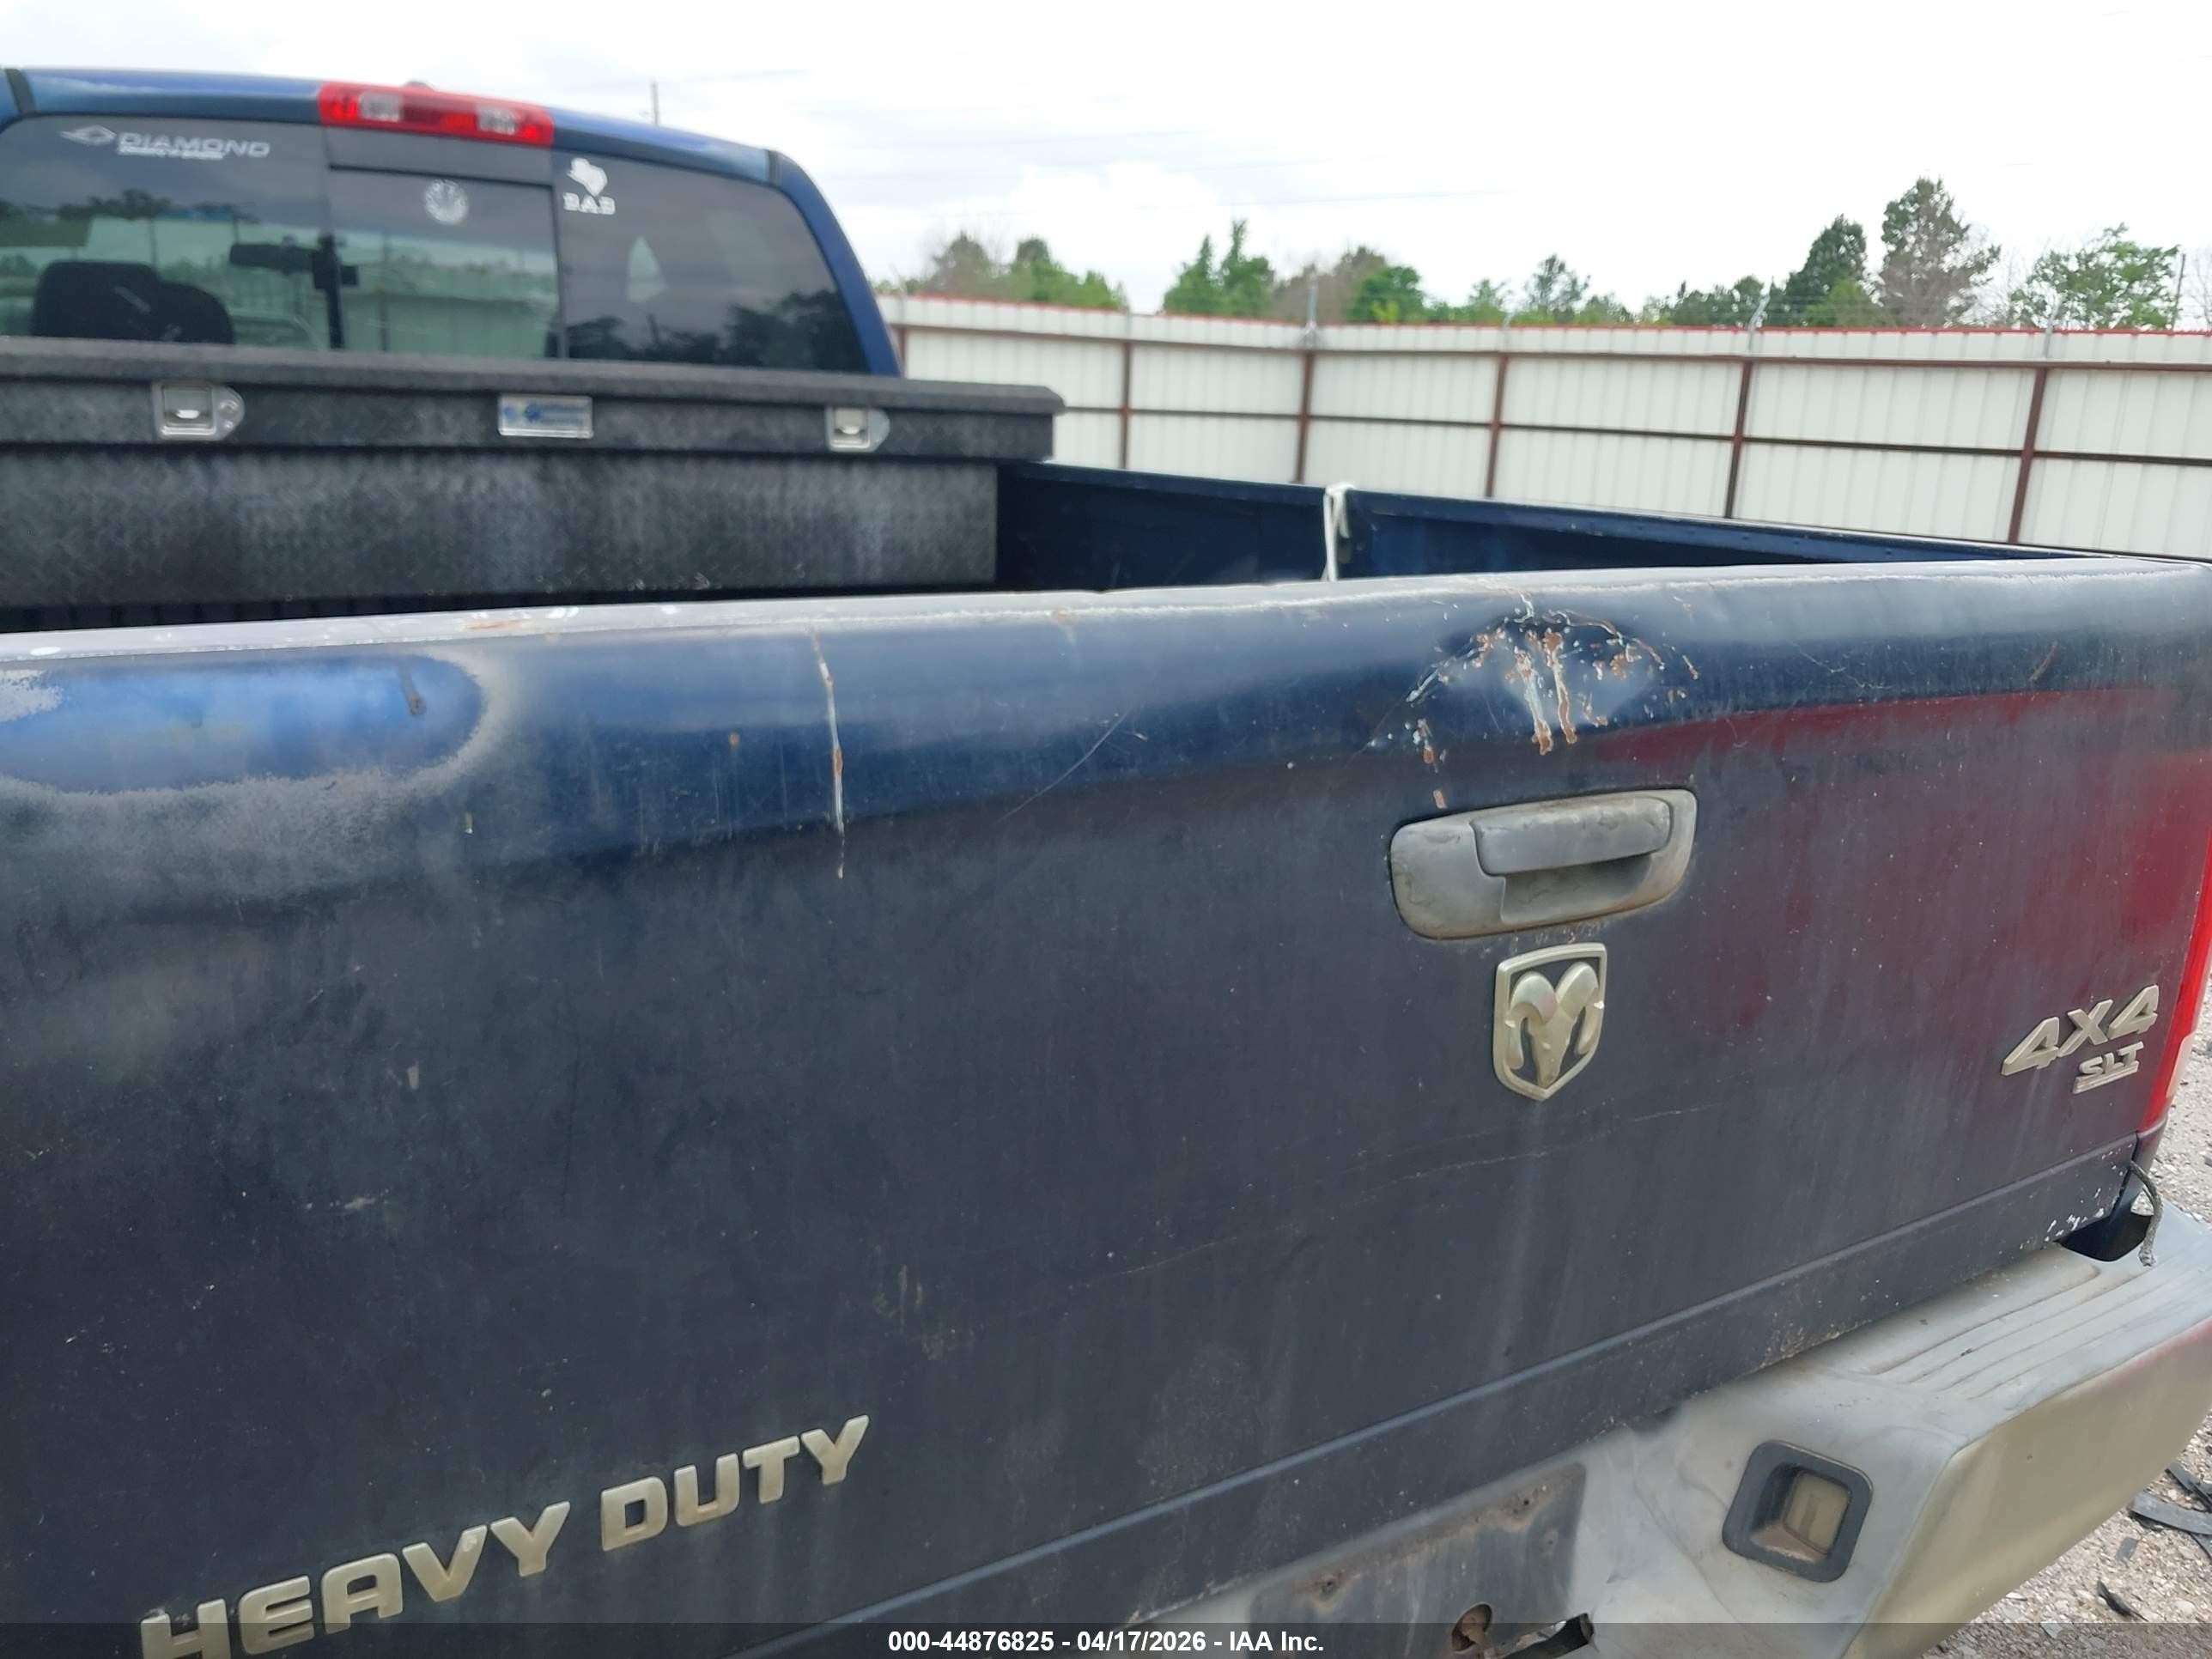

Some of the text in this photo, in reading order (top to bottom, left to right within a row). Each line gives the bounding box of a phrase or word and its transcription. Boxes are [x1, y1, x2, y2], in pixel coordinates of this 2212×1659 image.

[118, 132, 270, 159] DIAMOND
[2002, 984, 2159, 1076] 4X4
[2078, 1042, 2144, 1075] SLT
[140, 1415, 869, 1659] HEAVY DUTY
